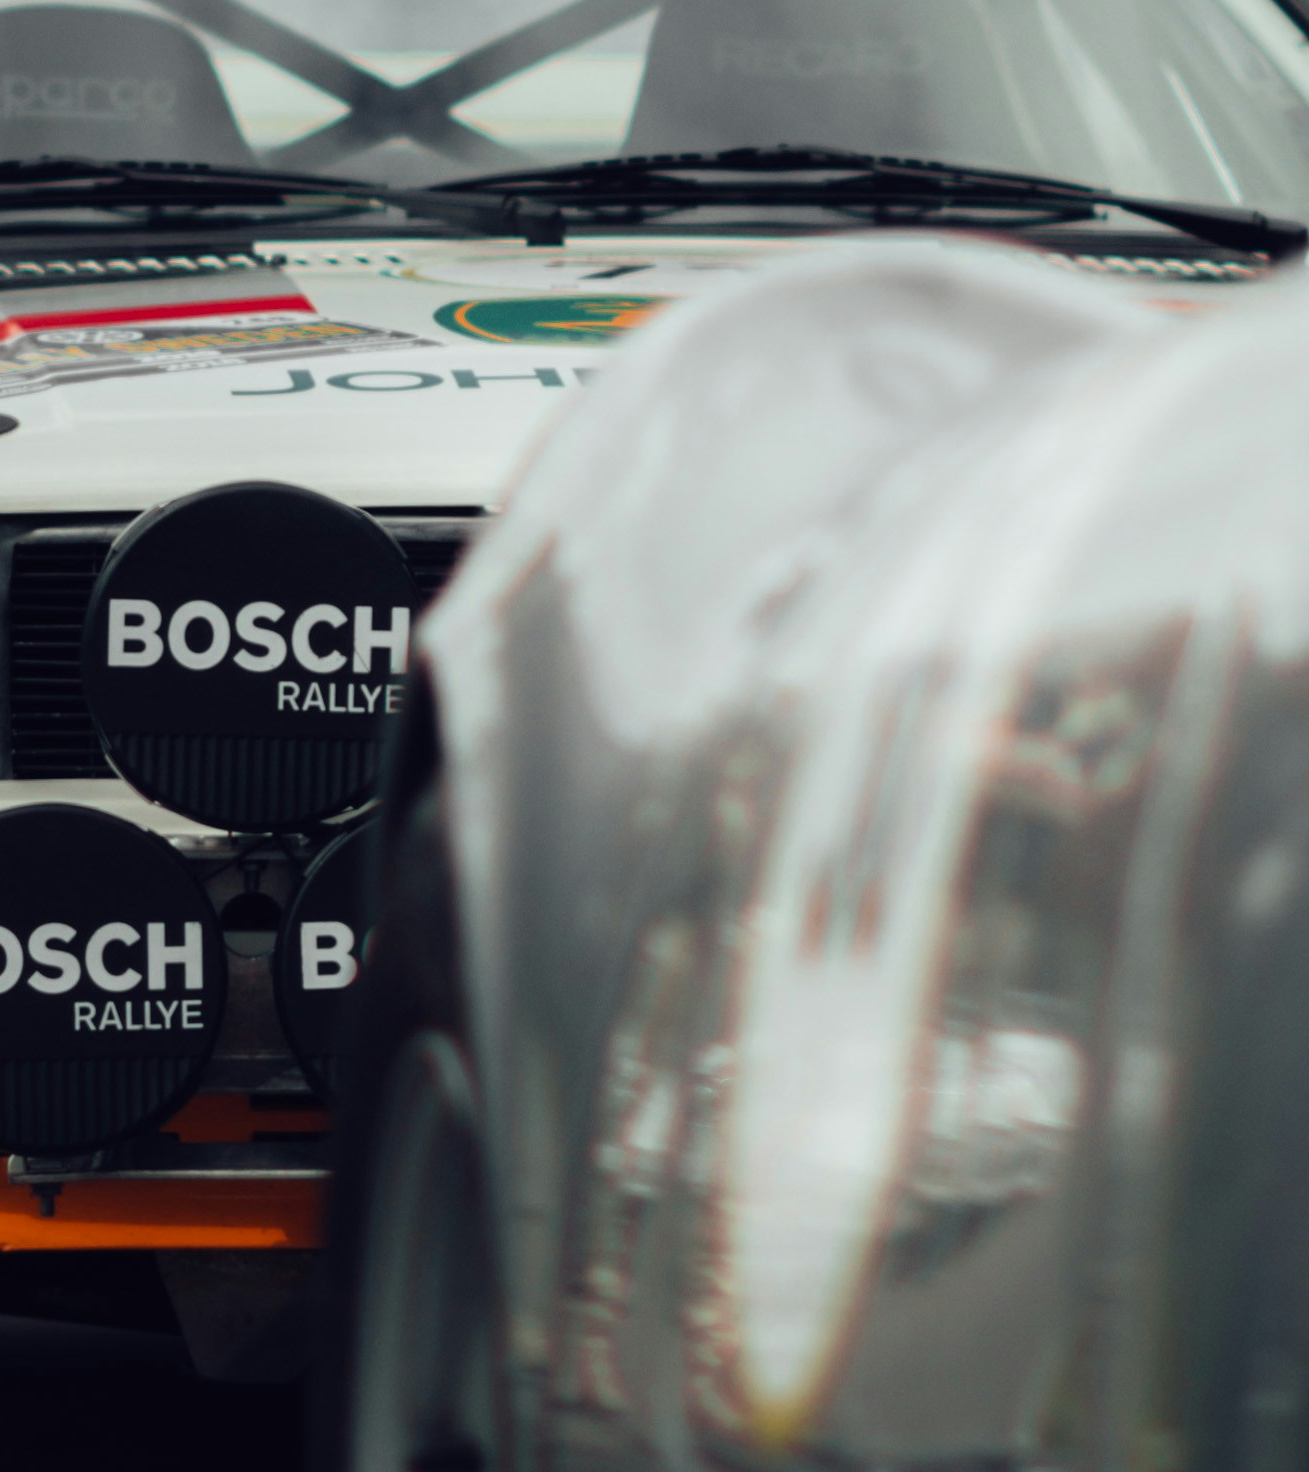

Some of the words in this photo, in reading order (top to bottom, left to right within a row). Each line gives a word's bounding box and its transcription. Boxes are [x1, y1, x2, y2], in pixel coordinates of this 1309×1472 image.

[230, 367, 597, 397] JOH
[107, 598, 410, 673] BOSCH
[277, 681, 404, 714] RALLYE
[300, 920, 370, 991] B
[74, 999, 205, 1031] RALLYE
